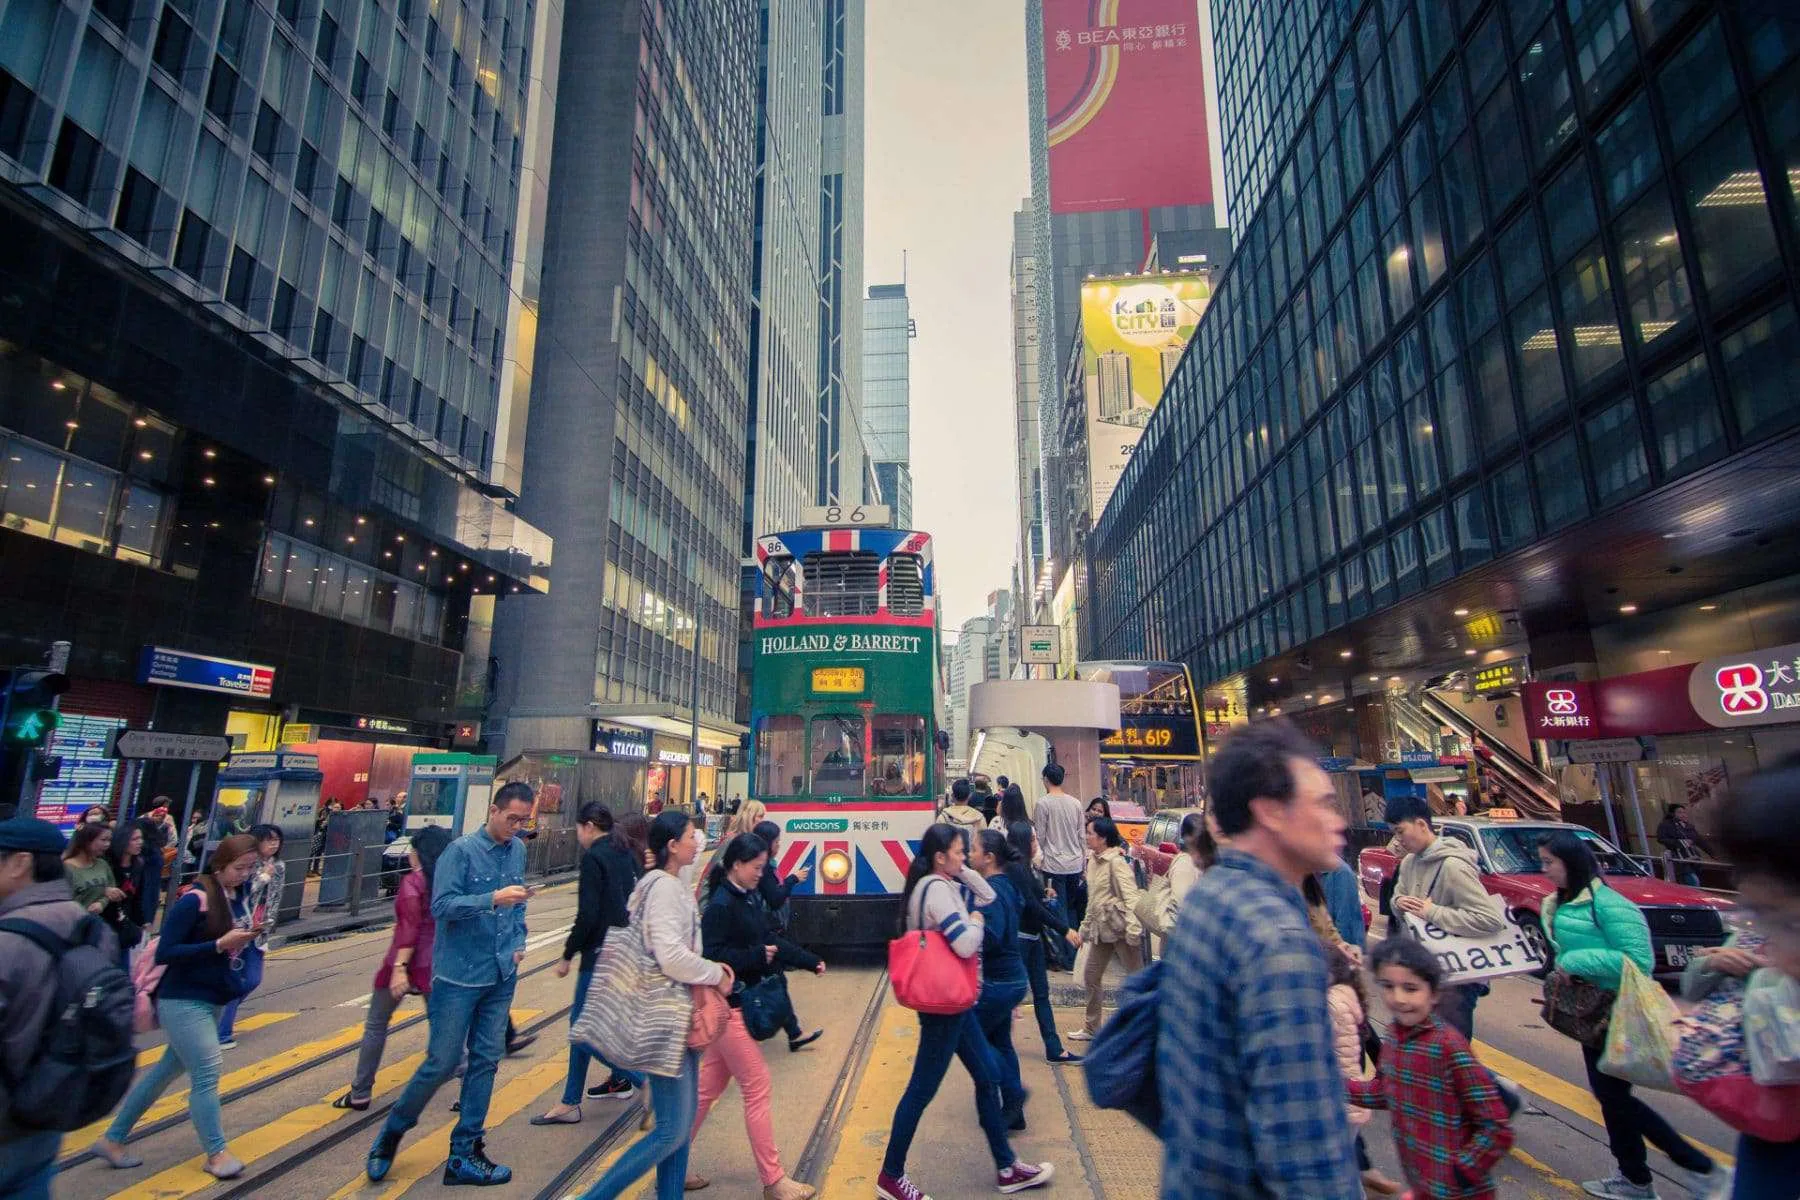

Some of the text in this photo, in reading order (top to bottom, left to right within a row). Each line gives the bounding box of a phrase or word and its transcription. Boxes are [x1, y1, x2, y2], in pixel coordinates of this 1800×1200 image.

[1078, 30, 1120, 44] BEA
[1122, 24, 1187, 40] 東亞銀行
[1116, 314, 1159, 329] CITY
[826, 505, 866, 522] 86
[767, 541, 782, 553] 86
[906, 540, 922, 551] 86
[762, 634, 921, 654] HOLLAND & BARRETT
[1765, 656, 1800, 687] 大
[219, 676, 250, 690] Travelex
[1540, 716, 1591, 727] 大新銀行
[176, 735, 195, 744] Road
[1145, 729, 1171, 746] 619
[612, 740, 647, 757] STACCATO
[659, 750, 691, 762] SKECHERS
[793, 821, 840, 830] watsons
